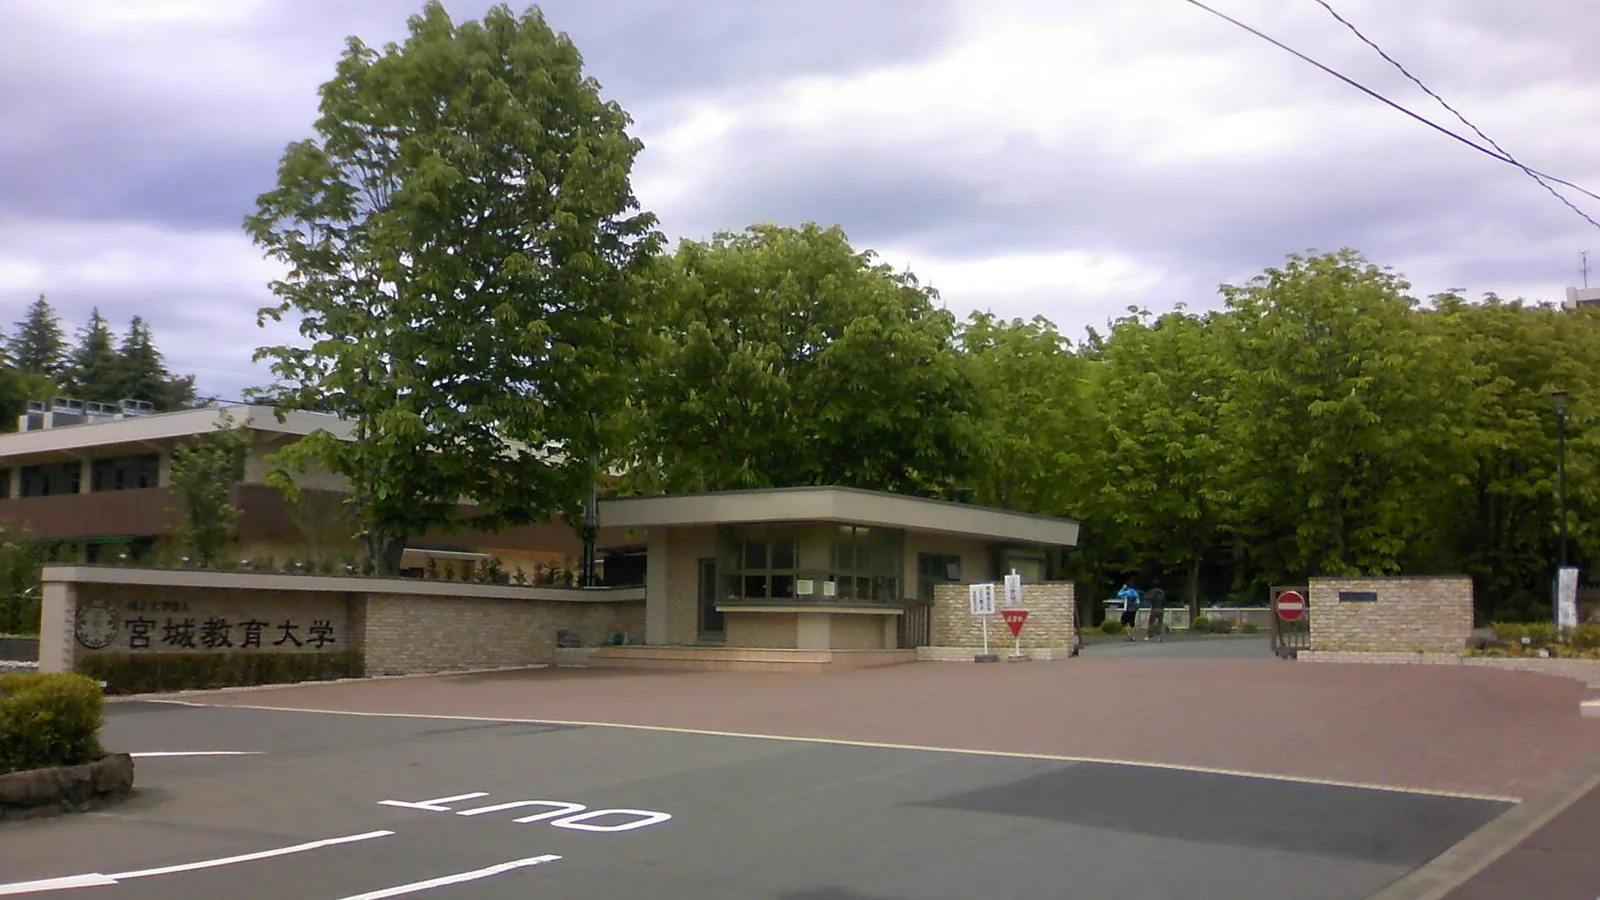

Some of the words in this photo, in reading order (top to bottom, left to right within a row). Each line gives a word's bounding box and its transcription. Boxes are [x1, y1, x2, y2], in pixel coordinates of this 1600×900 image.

[124, 616, 335, 649] 宮城教育大学
[376, 791, 672, 832] OUT
